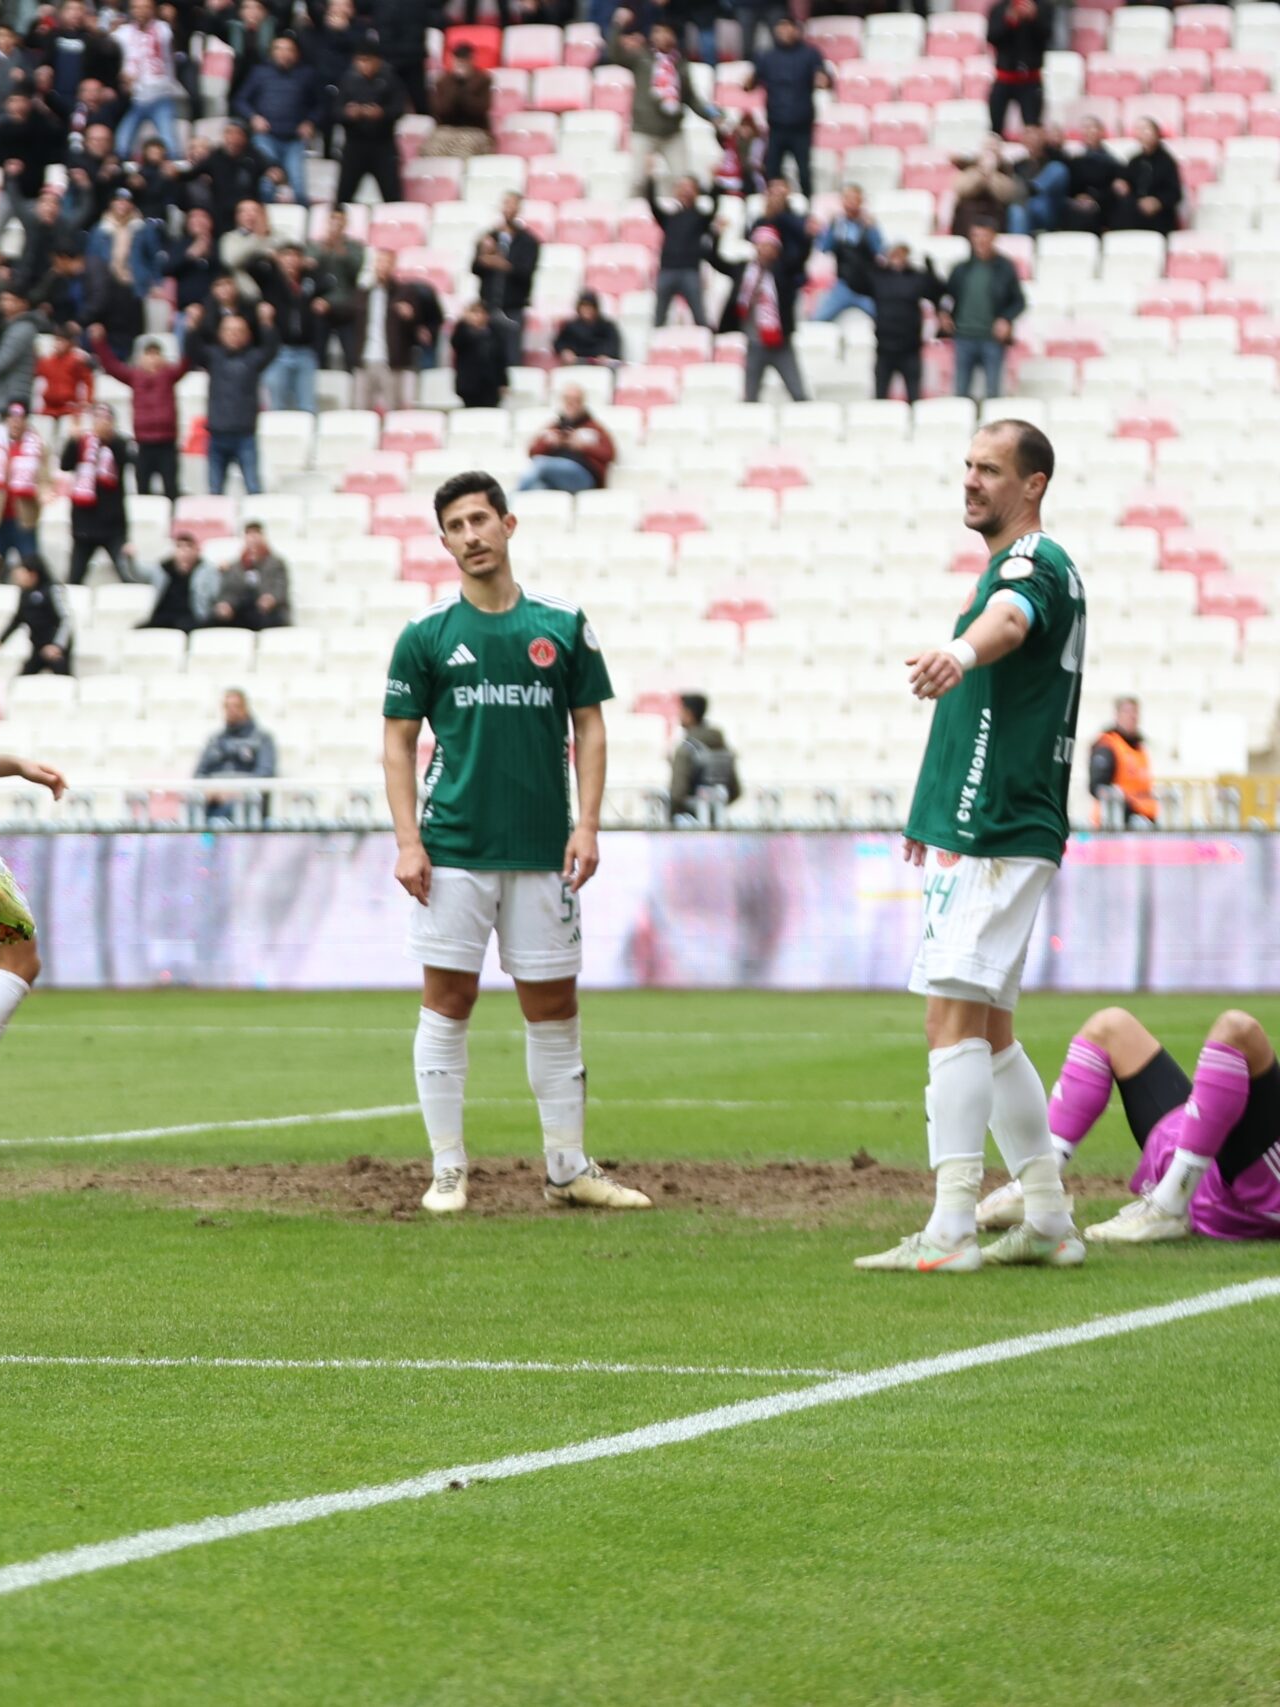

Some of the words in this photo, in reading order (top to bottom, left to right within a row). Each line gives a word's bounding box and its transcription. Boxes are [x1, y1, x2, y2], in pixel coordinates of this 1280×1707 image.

[452, 679, 555, 708] EMİNEVİN
[956, 785, 978, 823] CVK
[560, 882, 580, 923] 5
